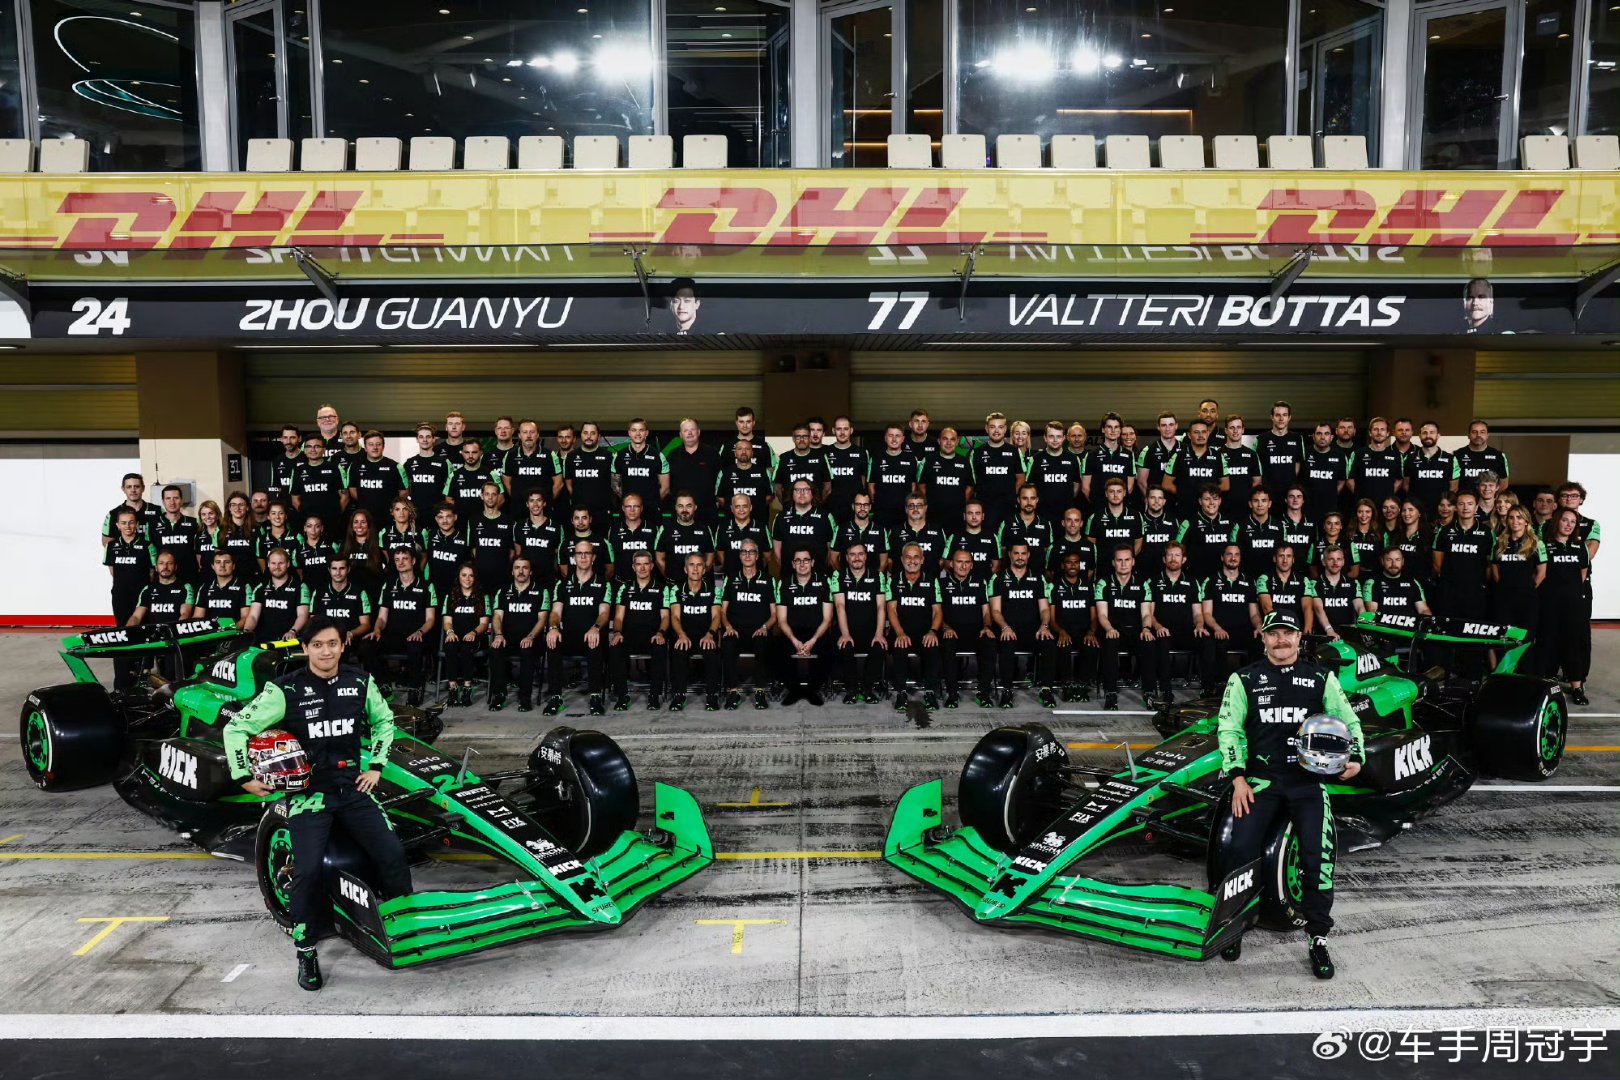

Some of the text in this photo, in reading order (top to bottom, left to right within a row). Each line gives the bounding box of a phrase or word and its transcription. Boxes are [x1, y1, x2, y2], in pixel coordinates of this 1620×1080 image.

[52, 190, 386, 249] DHL
[650, 186, 990, 249] DHL
[1252, 188, 1584, 249] DHL
[868, 292, 930, 330] 77
[1008, 294, 1406, 327] VALTTERI BOTTAS
[68, 297, 131, 335] 24
[239, 297, 574, 334] ZHOU GUANYU
[230, 459, 240, 474] 31
[832, 467, 853, 475] KICK
[1103, 464, 1124, 473] KICK
[628, 468, 649, 476] KICK
[1190, 468, 1212, 477] KICK
[1310, 470, 1333, 479] KICK
[1366, 468, 1389, 477] KICK
[413, 474, 434, 483] KICK
[937, 476, 959, 485] KICK
[1045, 474, 1067, 482] KICK
[304, 484, 327, 492] KICK
[361, 479, 382, 488] KICK
[460, 490, 482, 498] KICK
[790, 526, 813, 534] KICK
[162, 536, 188, 544] KICK
[479, 538, 500, 546] KICK
[526, 538, 548, 547] KICK
[1147, 534, 1169, 542] KICK
[1206, 534, 1227, 543] KICK
[1287, 535, 1309, 543] KICK
[623, 541, 647, 550] KICK
[1252, 540, 1274, 548] KICK
[1452, 544, 1477, 553] KICK
[675, 545, 698, 554] KICK
[433, 550, 457, 561] KICK
[974, 553, 986, 561] CK
[305, 557, 326, 565] KICK
[737, 592, 761, 602] KICK
[848, 591, 870, 601] KICK
[1009, 590, 1033, 598] KICK
[1163, 594, 1186, 603] KICK
[1222, 594, 1245, 602] KICK
[1273, 594, 1295, 603] KICK
[209, 600, 231, 608] KICK
[266, 599, 288, 609] KICK
[394, 600, 416, 610] KICK
[570, 597, 593, 605] KICK
[630, 601, 652, 610] KICK
[794, 597, 817, 605] KICK
[901, 597, 925, 606] KICK
[1062, 600, 1086, 608] KICK
[1114, 599, 1136, 608] KICK
[1325, 598, 1348, 607] KICK
[1383, 597, 1406, 605] KICK
[151, 604, 174, 612] KICK
[509, 603, 532, 612] KICK
[684, 605, 707, 614] KICK
[327, 609, 349, 617] KICK
[1381, 614, 1415, 627] KICK
[176, 621, 212, 634] KICK
[1463, 623, 1500, 635] KICK
[90, 630, 128, 644] KICK
[1358, 653, 1380, 674] KICK
[212, 660, 235, 682] KICK
[1293, 676, 1315, 687] KICK
[337, 688, 358, 696] KICK
[1259, 707, 1308, 724] KICK
[308, 719, 354, 739] KICK
[235, 749, 245, 769] KICK
[1395, 735, 1434, 782] KICK
[159, 740, 197, 790] KICK
[289, 792, 326, 818] 24
[548, 860, 582, 876] KICK
[1013, 856, 1047, 872] KICK
[1224, 869, 1253, 900] KICK
[340, 878, 369, 908] KICK
